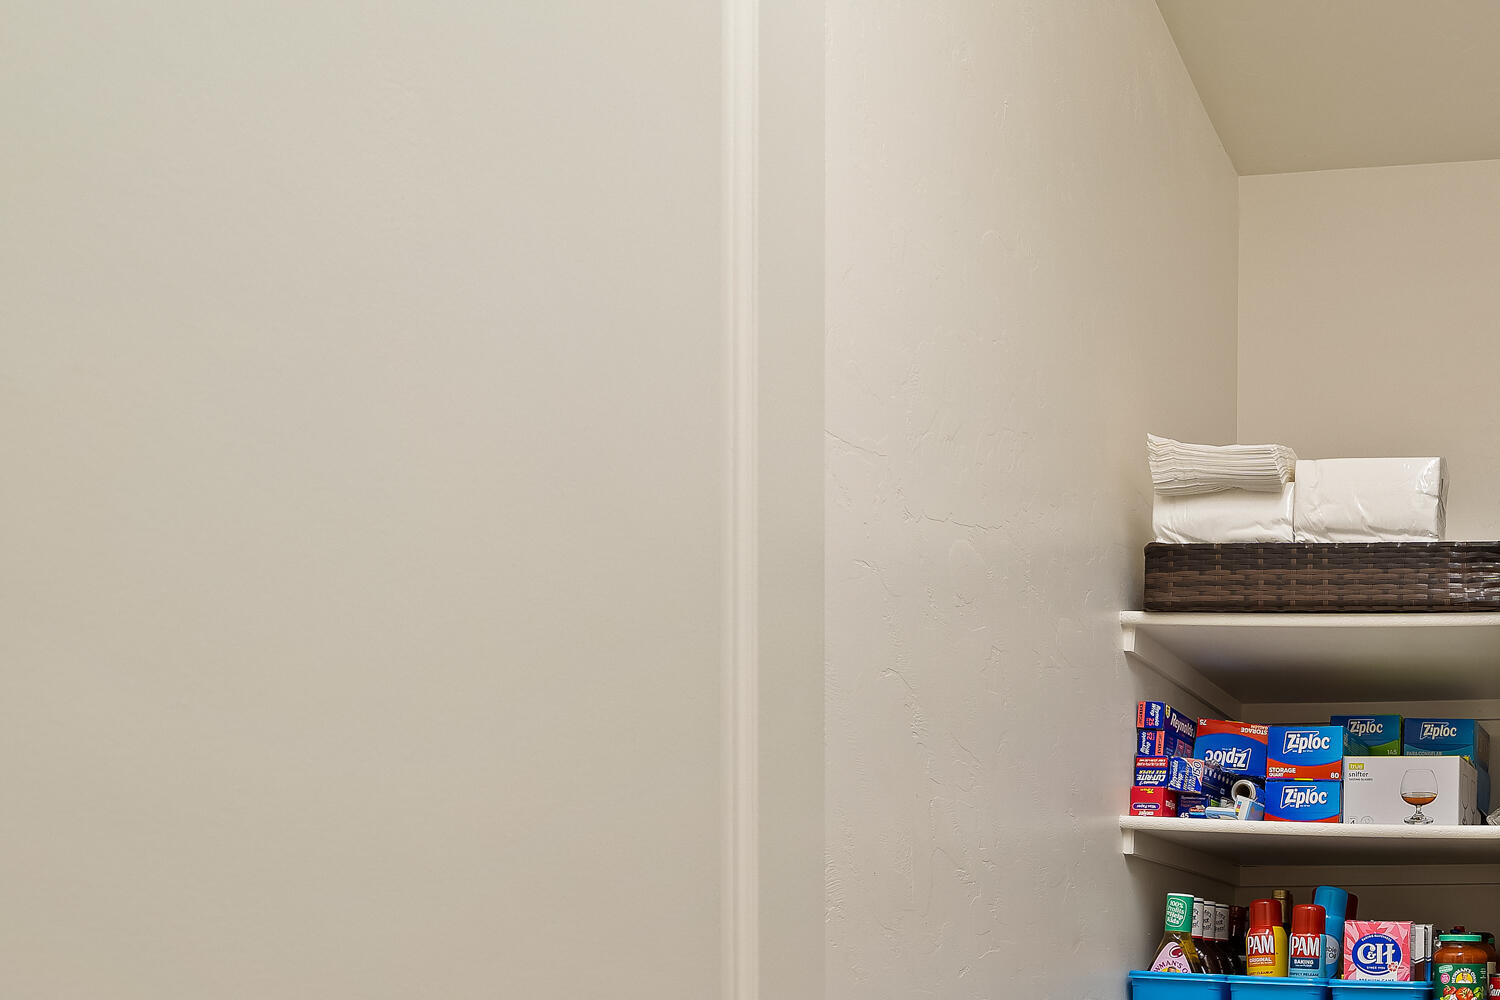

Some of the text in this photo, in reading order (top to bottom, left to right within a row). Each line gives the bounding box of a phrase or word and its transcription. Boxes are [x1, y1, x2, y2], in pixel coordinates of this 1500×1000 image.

[1170, 712, 1195, 738] Reynolds
[1240, 727, 1269, 736] STORAGE
[1350, 720, 1384, 737] Ziploc
[1423, 723, 1457, 740] Ziploc
[1287, 733, 1330, 753] Ziploc
[1204, 747, 1247, 768] Ziploc
[1285, 788, 1327, 809] Ziploc
[1247, 935, 1275, 955] PAM
[1291, 936, 1319, 956] PAM
[1357, 943, 1396, 965] C&H
